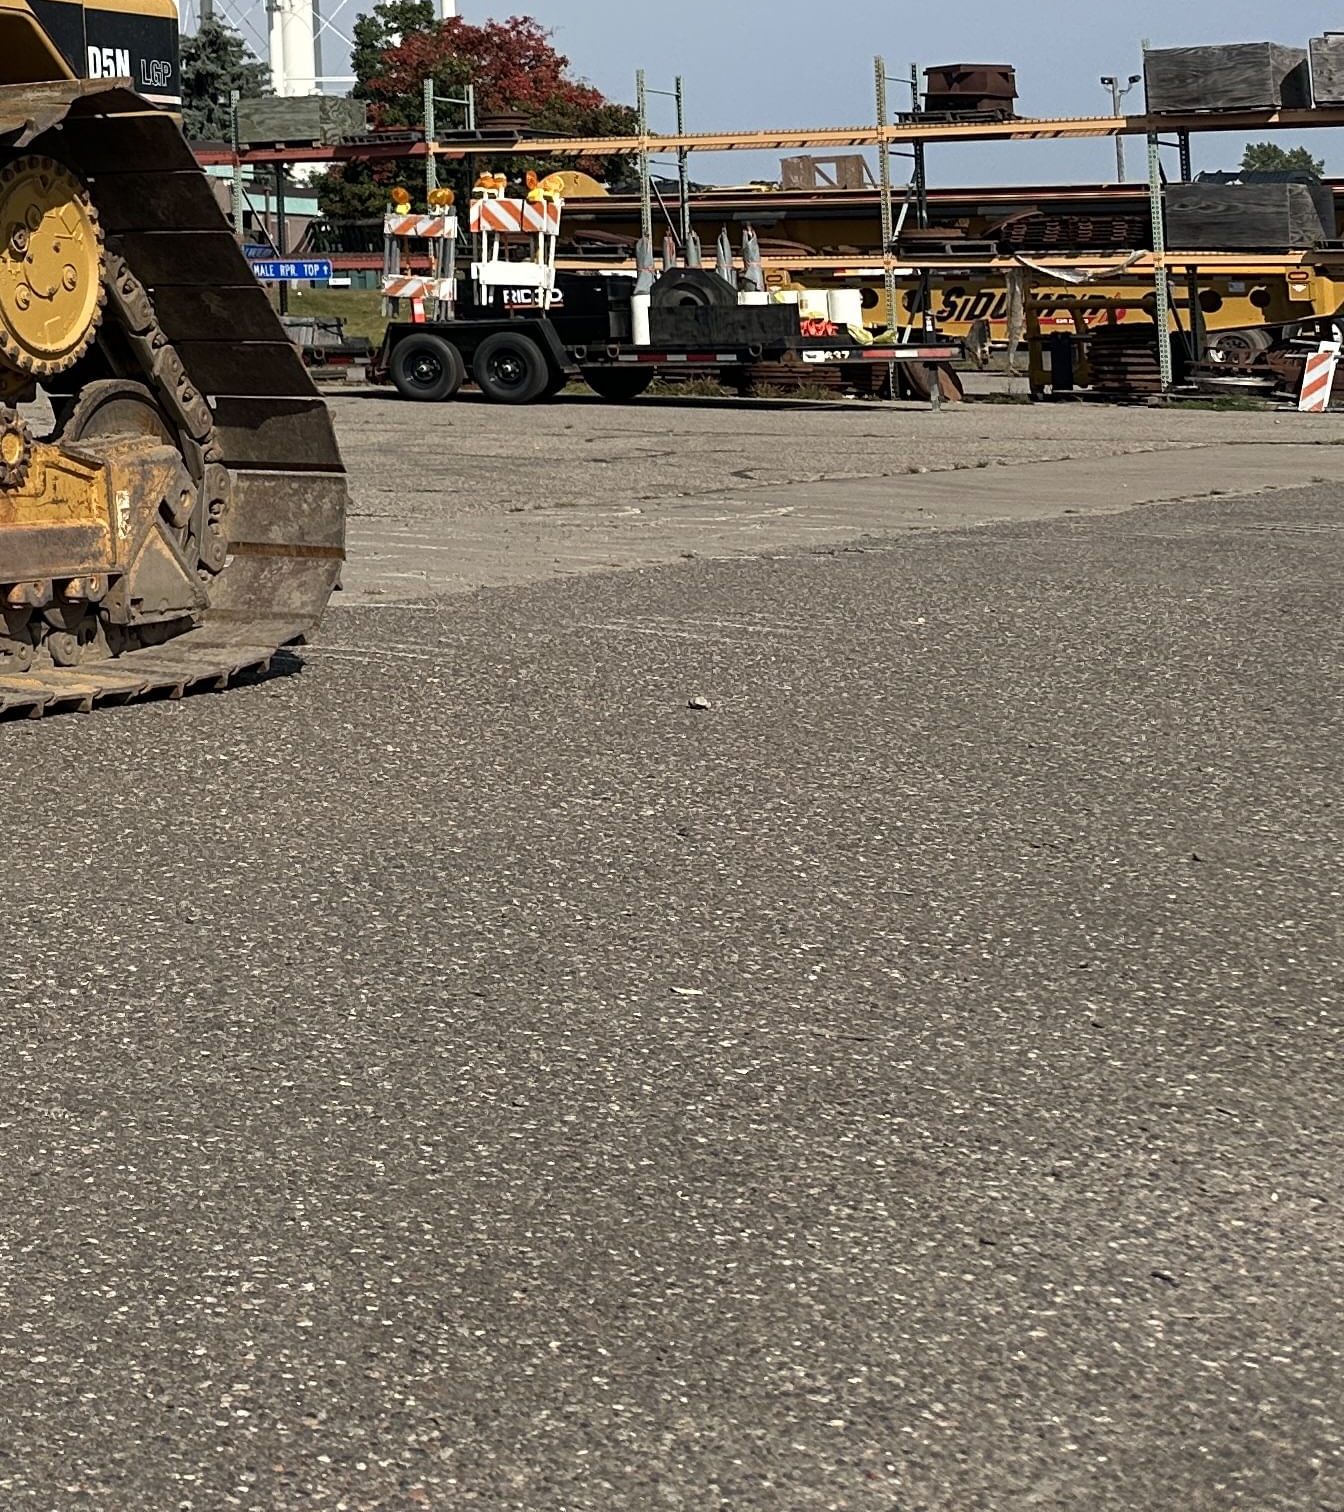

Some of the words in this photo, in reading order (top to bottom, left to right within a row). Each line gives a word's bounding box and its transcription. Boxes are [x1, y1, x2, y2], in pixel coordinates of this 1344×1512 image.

[87, 45, 131, 79] D5N
[140, 58, 173, 87] LGP
[253, 264, 275, 277] MALE
[303, 264, 320, 277] TOP
